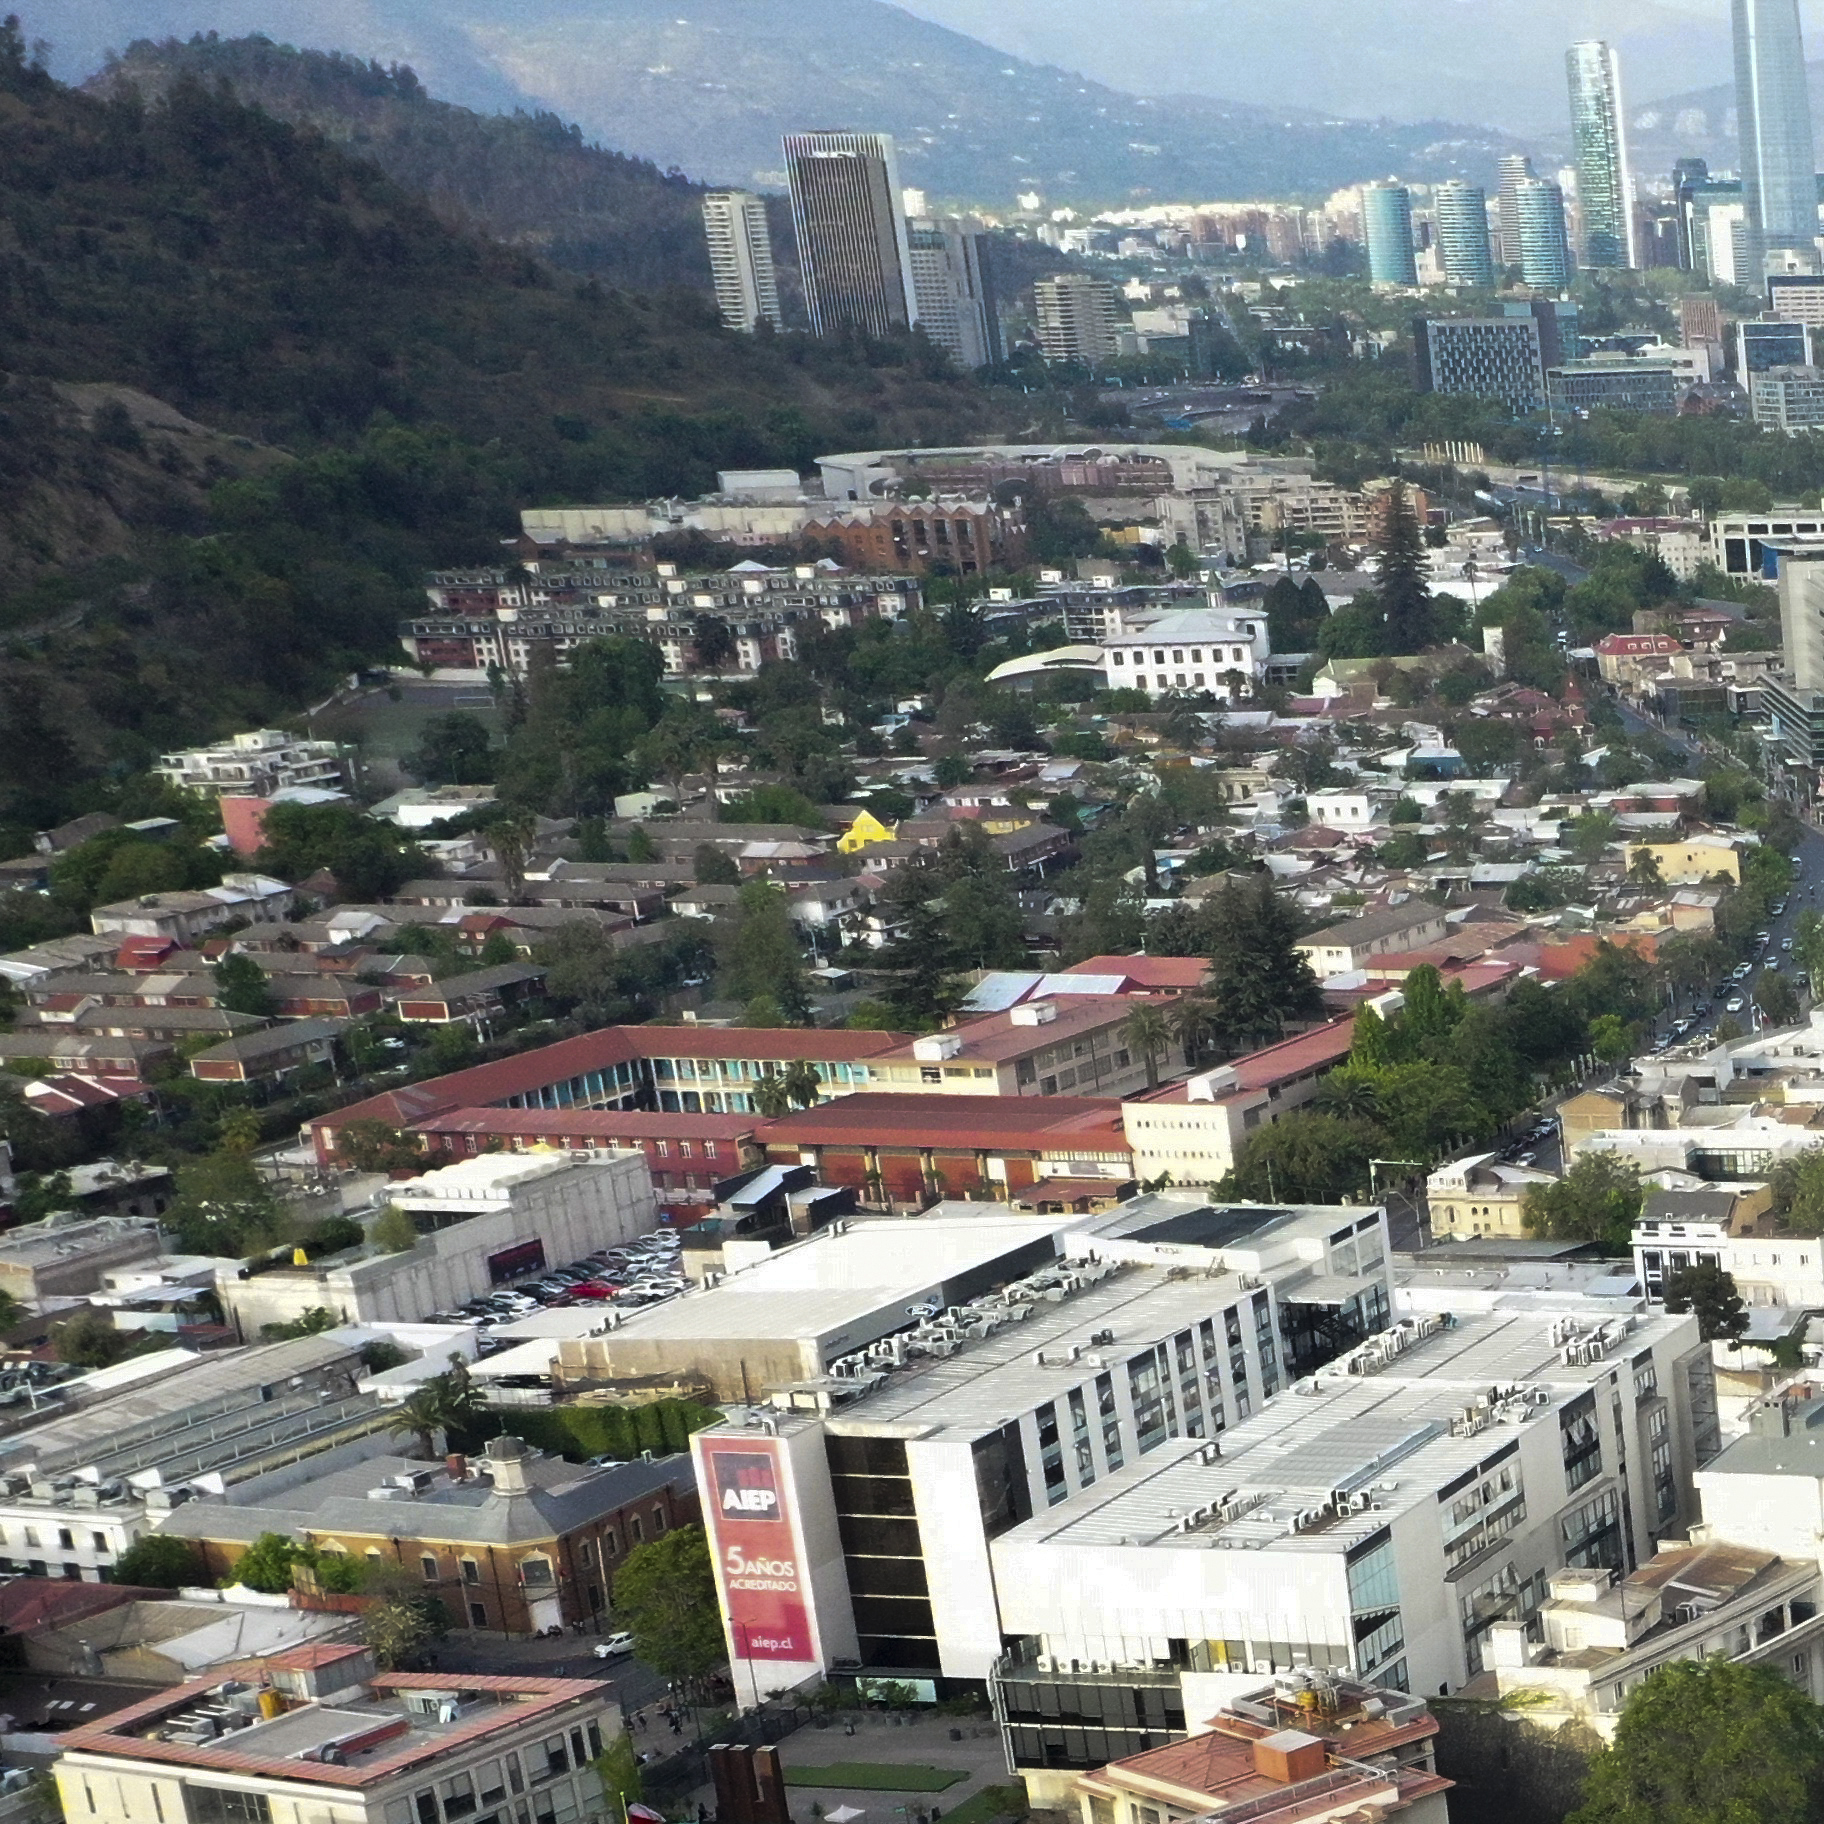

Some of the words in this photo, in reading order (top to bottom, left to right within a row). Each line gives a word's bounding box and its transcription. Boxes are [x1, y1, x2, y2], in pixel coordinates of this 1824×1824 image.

[723, 1489, 776, 1511] AIEP
[726, 1547, 743, 1575] 5
[743, 1557, 794, 1577] AÑOS
[730, 1578, 797, 1592] ACREDITADO
[751, 1635, 793, 1652] aiep.cl
